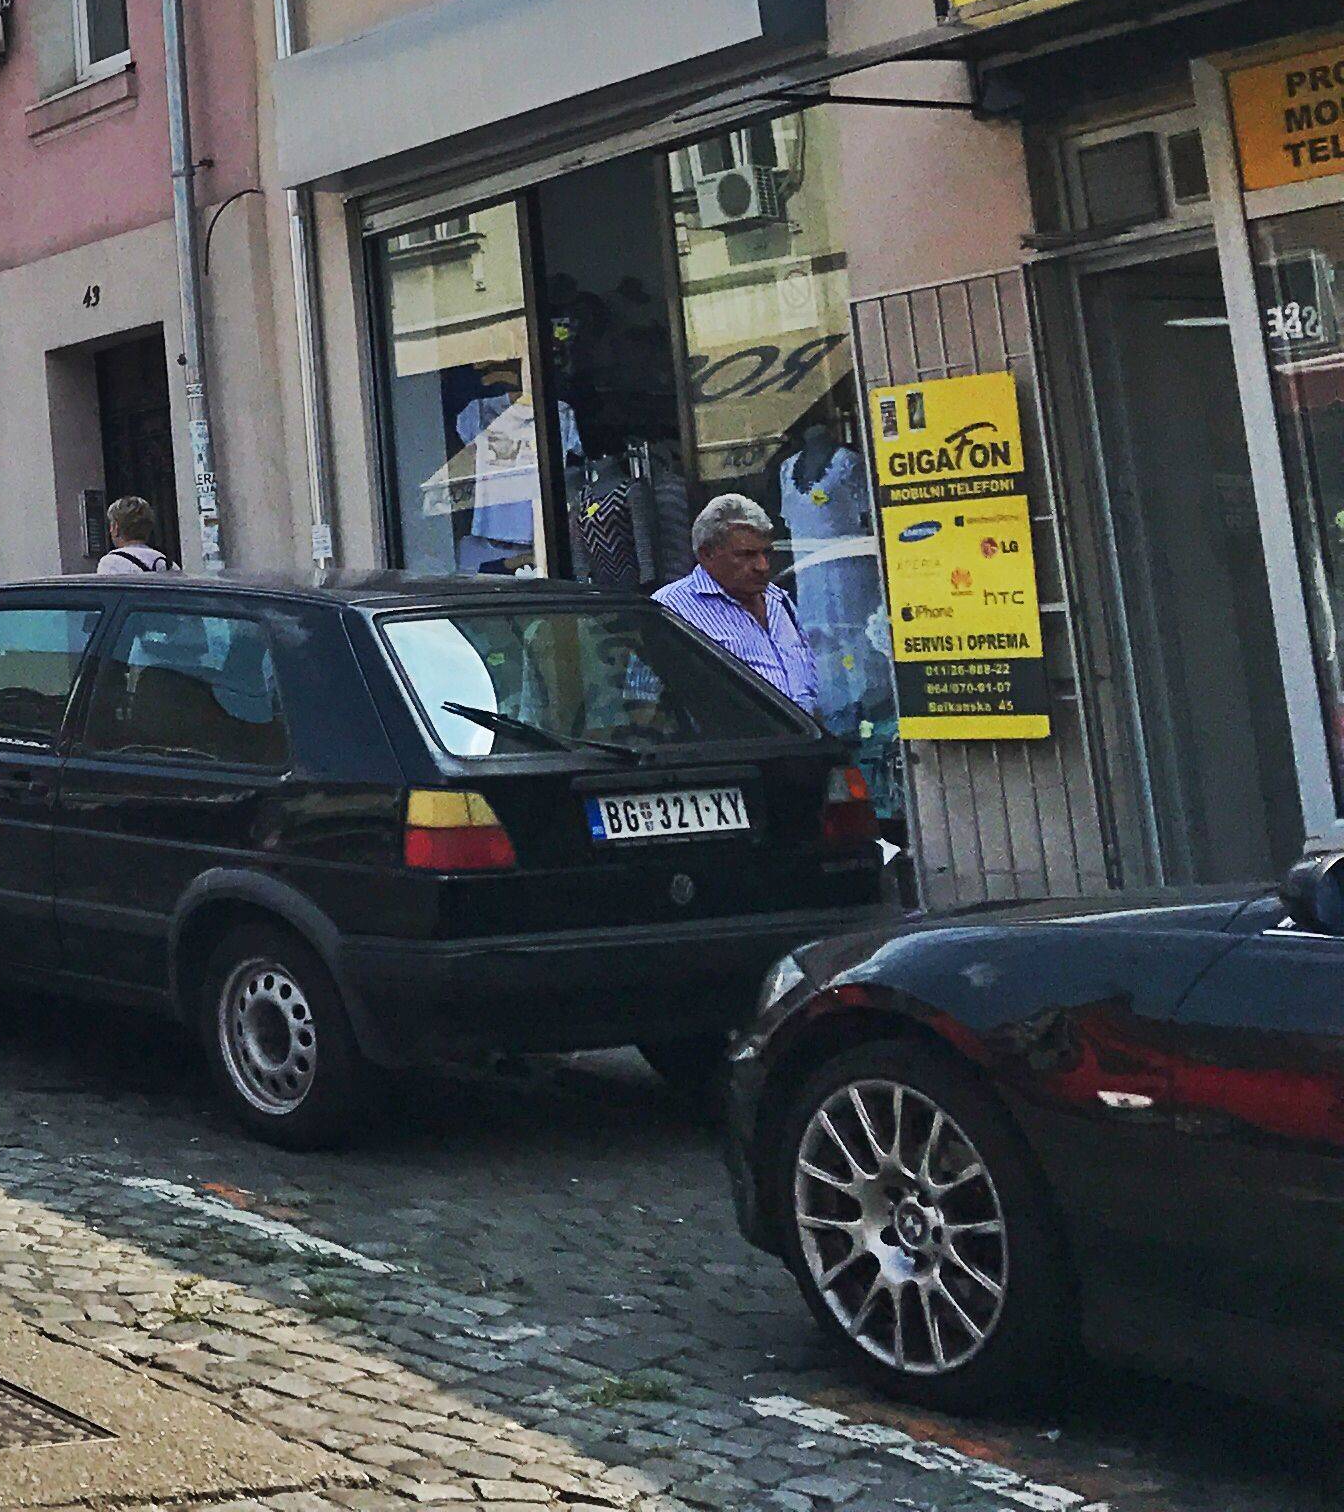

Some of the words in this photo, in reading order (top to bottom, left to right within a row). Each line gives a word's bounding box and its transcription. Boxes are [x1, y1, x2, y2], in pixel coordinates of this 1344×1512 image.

[83, 285, 100, 308] 43
[888, 422, 1012, 477] GIGAFON
[891, 484, 945, 501] MOBILNI
[948, 478, 1015, 496] TELEFONI
[1001, 540, 1019, 554] LG
[904, 635, 953, 653] SERVIS
[967, 632, 1031, 650] OPREMA
[605, 800, 641, 834] BG
